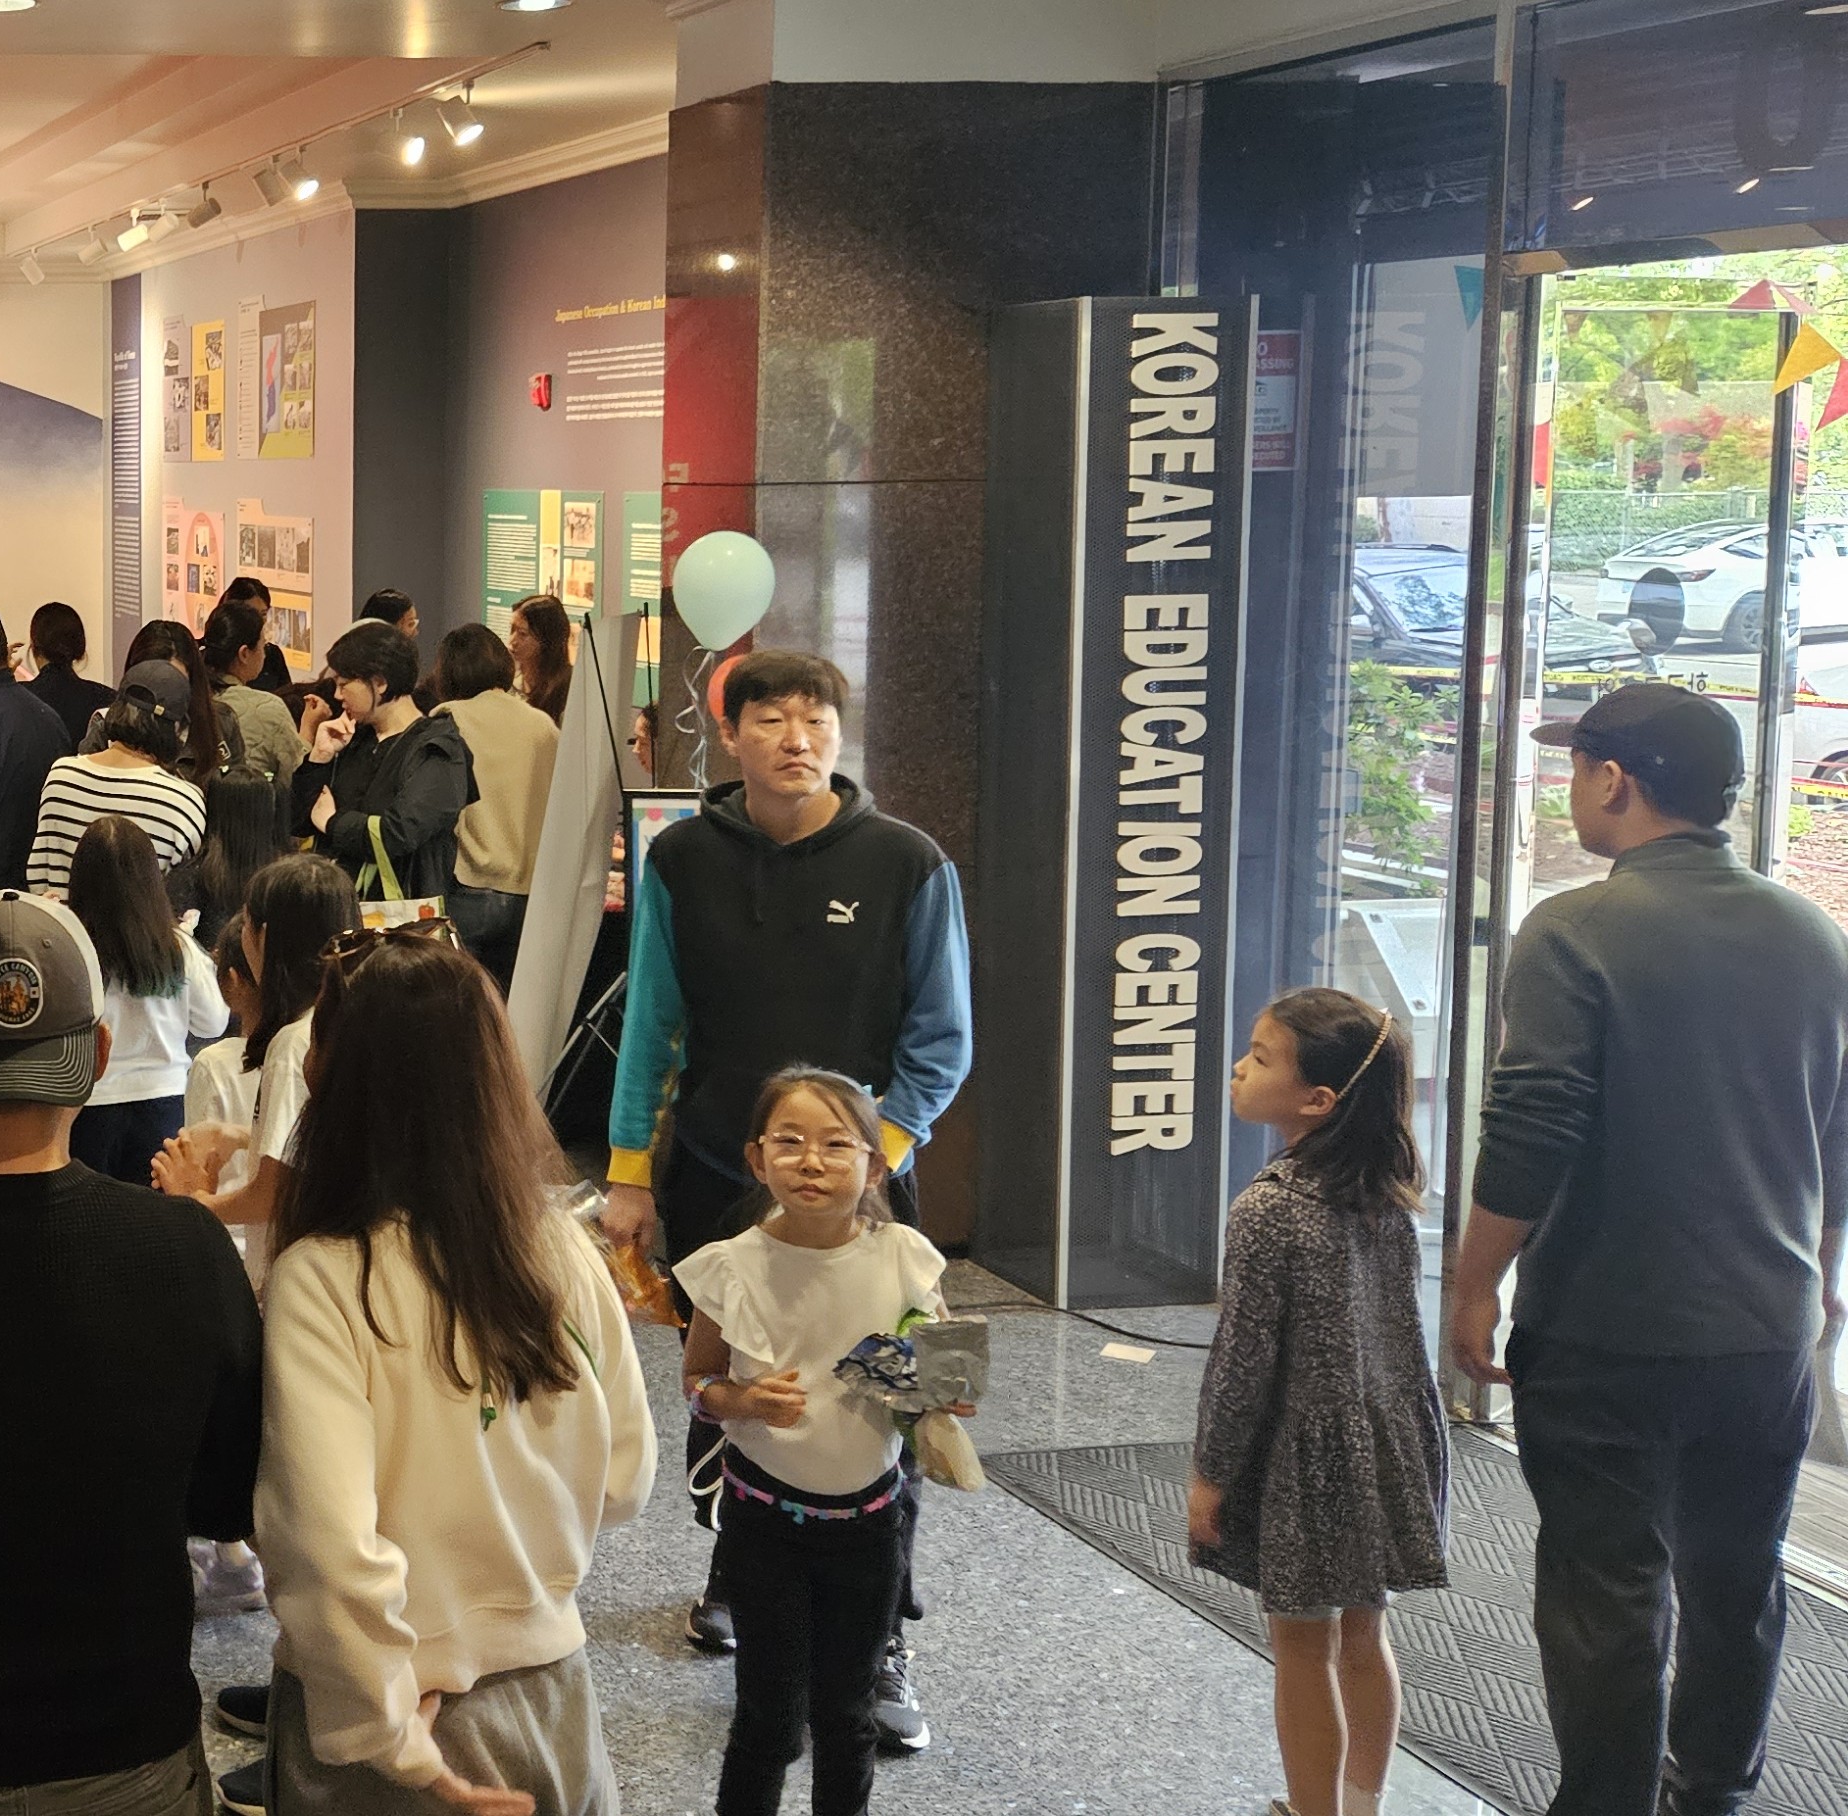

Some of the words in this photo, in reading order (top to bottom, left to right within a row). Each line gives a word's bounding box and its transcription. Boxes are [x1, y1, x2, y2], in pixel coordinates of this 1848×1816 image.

[627, 299, 652, 313] Korean
[1126, 312, 1219, 562] KOREAN
[1116, 593, 1209, 917] EDUCATION
[10, 963, 37, 985] CANYON
[1110, 933, 1201, 1157] CENTER
